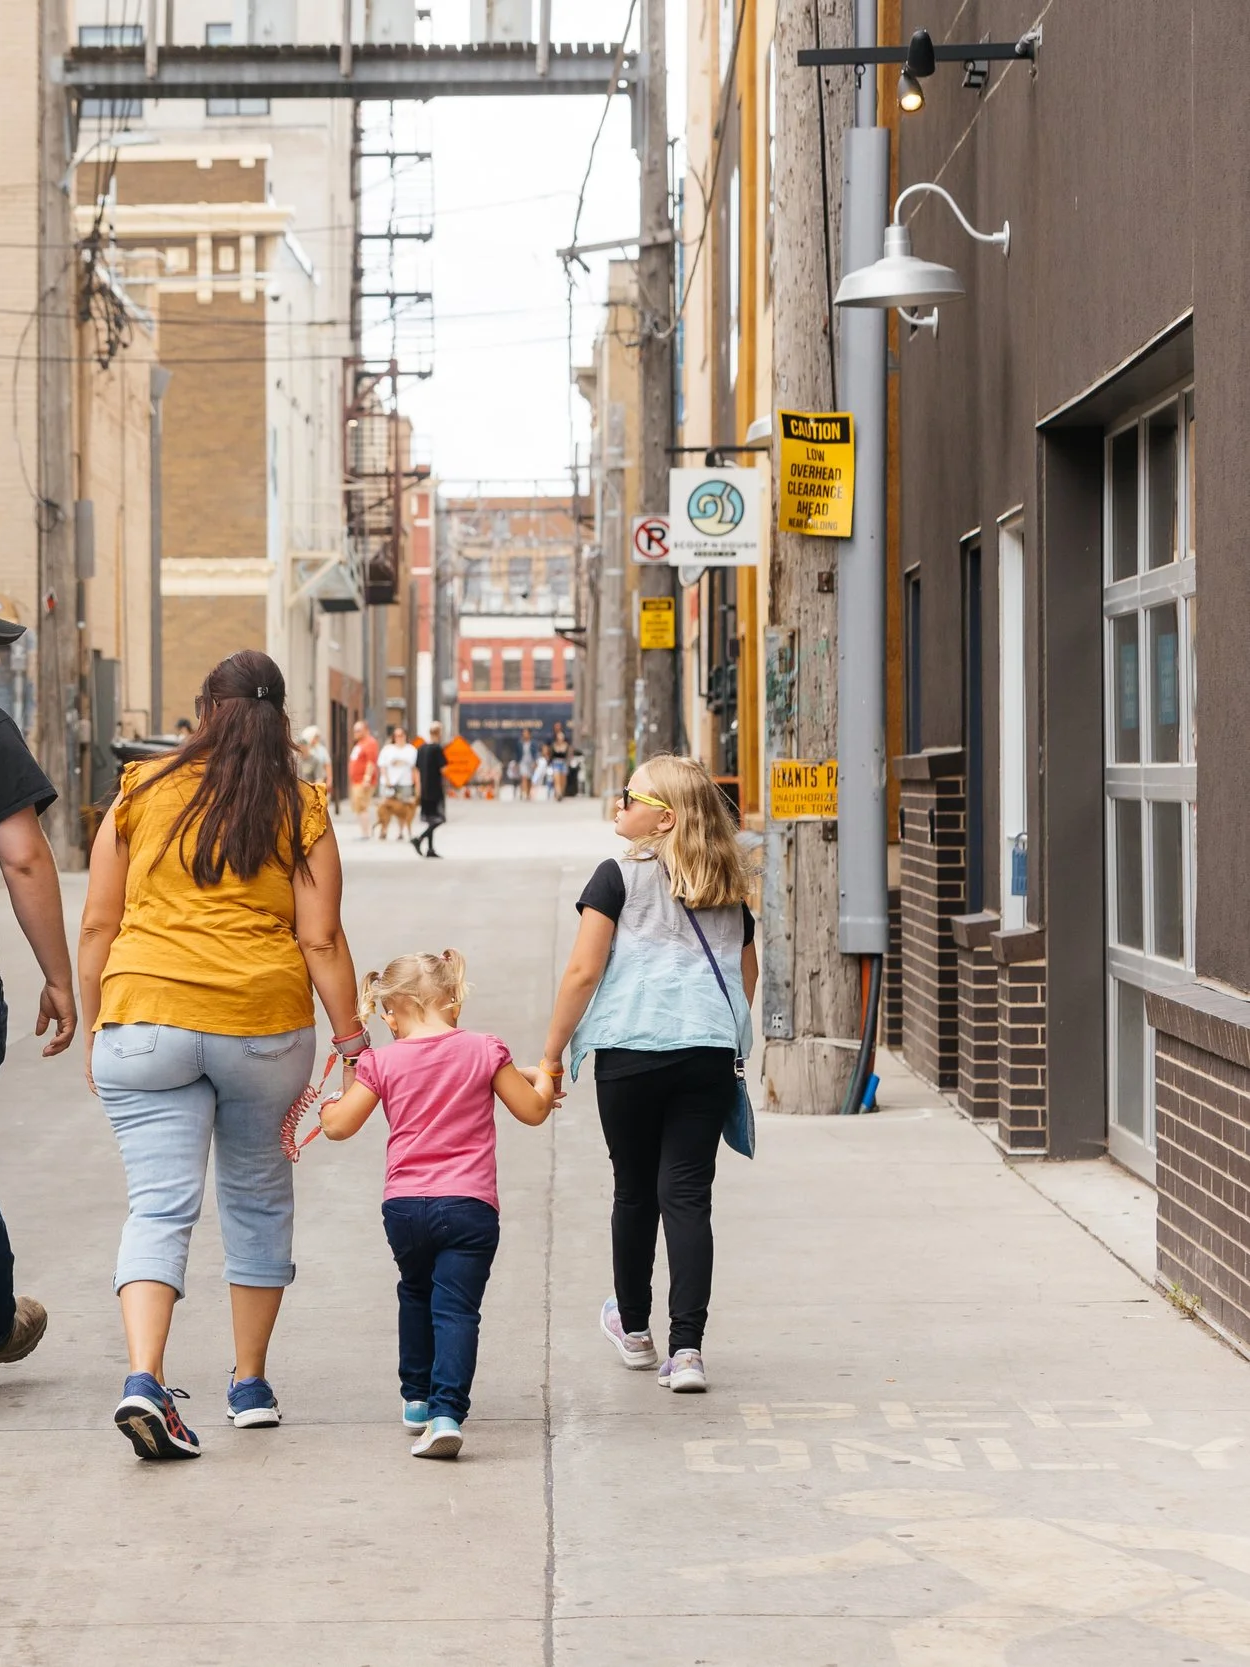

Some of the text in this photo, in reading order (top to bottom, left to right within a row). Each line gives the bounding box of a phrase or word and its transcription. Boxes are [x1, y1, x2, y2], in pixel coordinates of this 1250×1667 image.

[790, 419, 841, 440] CAUTION
[806, 447, 825, 462] LOW
[790, 463, 842, 481] OVERHEAD
[787, 481, 843, 499] CLEARANCE
[796, 500, 829, 516] AHEAD
[788, 517, 804, 528] NEAR
[773, 766, 818, 788] TENANTS
[738, 1399, 1155, 1430] PED
[682, 1437, 1248, 1474] ONLY
